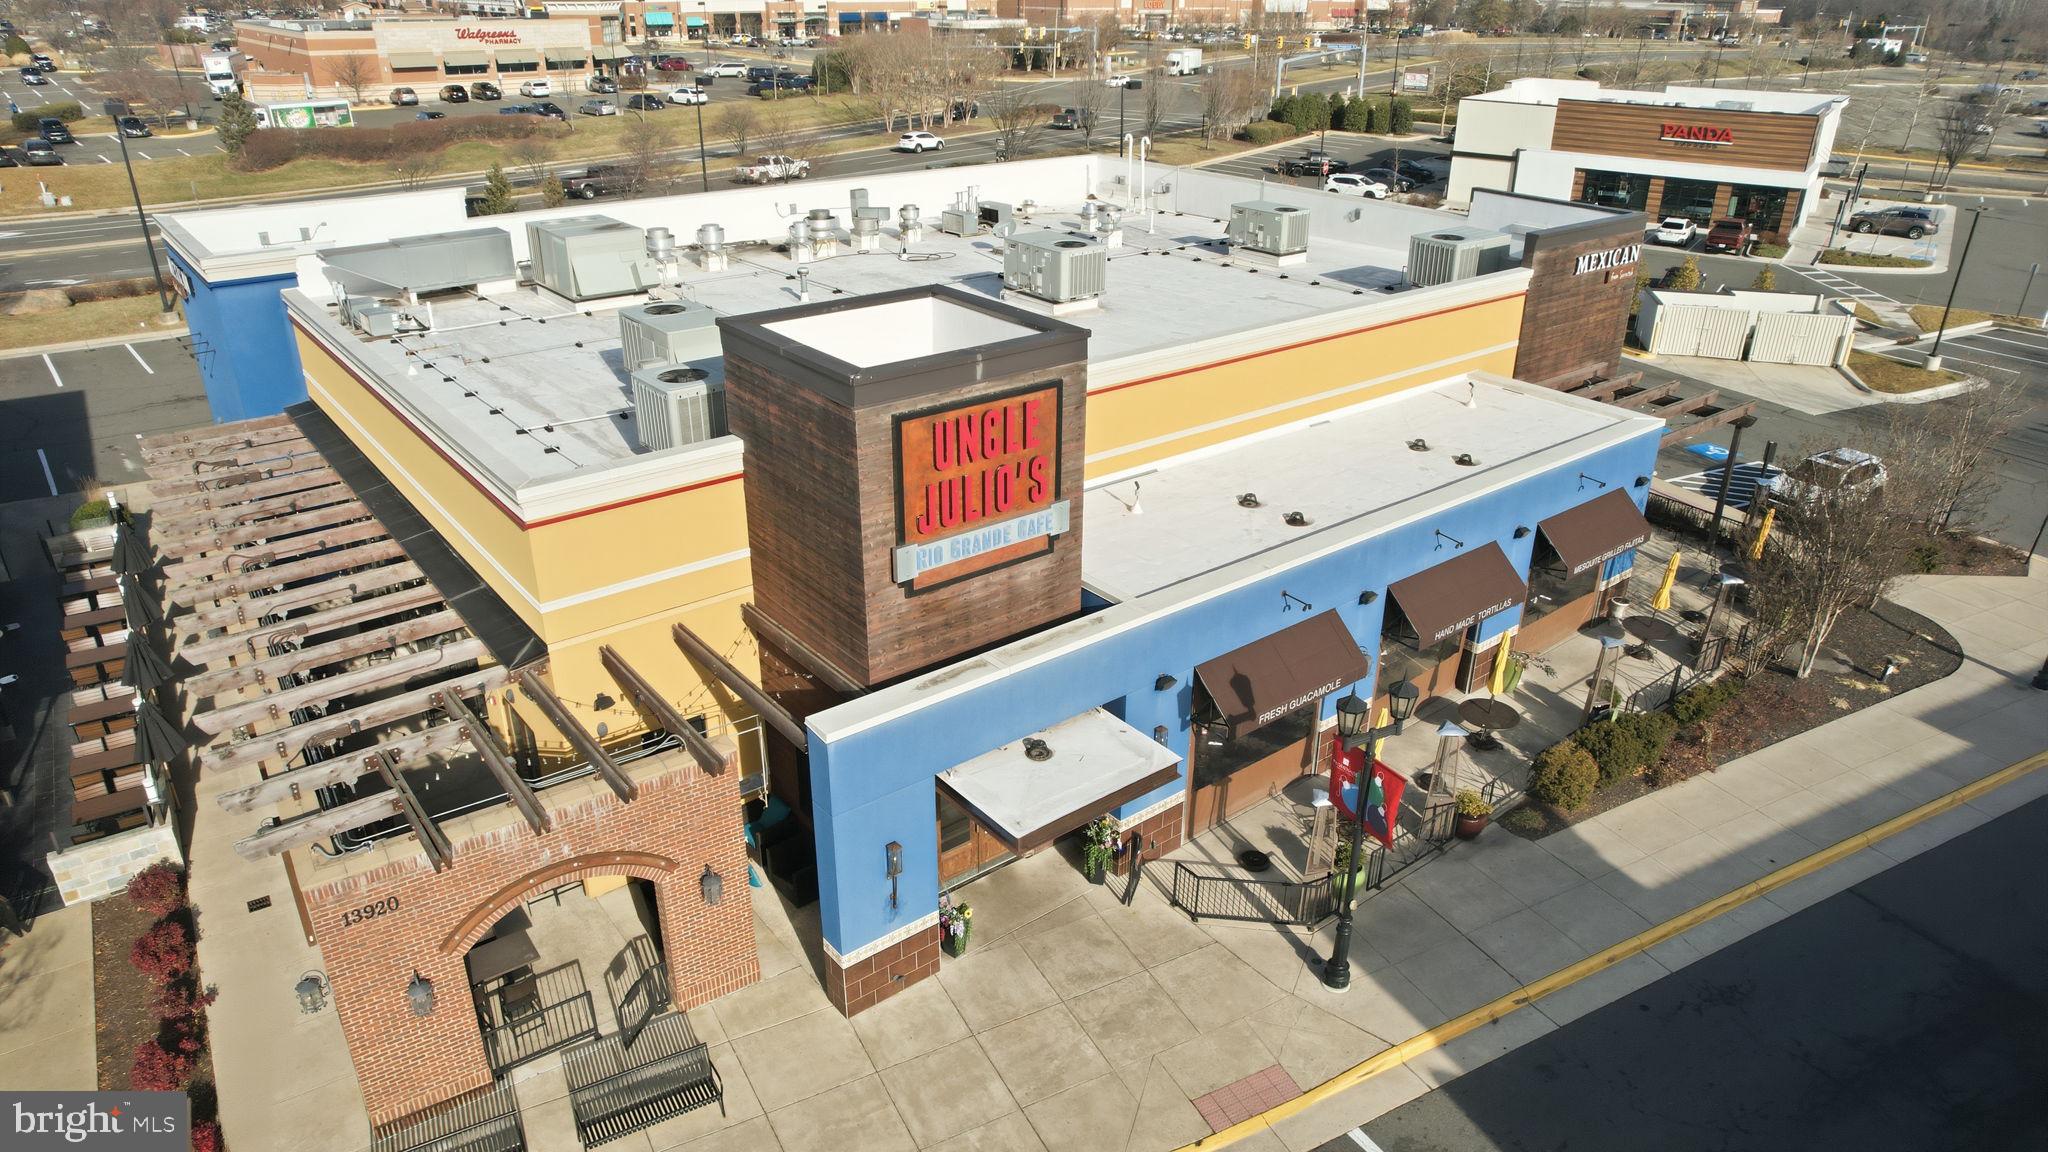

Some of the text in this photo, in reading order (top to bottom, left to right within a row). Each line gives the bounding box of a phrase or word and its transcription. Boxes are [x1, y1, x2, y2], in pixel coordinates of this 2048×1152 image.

[455, 28, 516, 42] Walgreens
[1661, 123, 1734, 142] PANDA
[1574, 244, 1642, 275] MEXICAN
[933, 400, 1041, 471] UNCLE
[917, 455, 1049, 535] JULIO'S
[916, 512, 1053, 571] RIO GRANDE CAFE
[1434, 598, 1512, 640] HAND MADE TORTILLAS
[1258, 678, 1342, 725] FRESH GUACAMOLE
[341, 896, 399, 928] 13920
